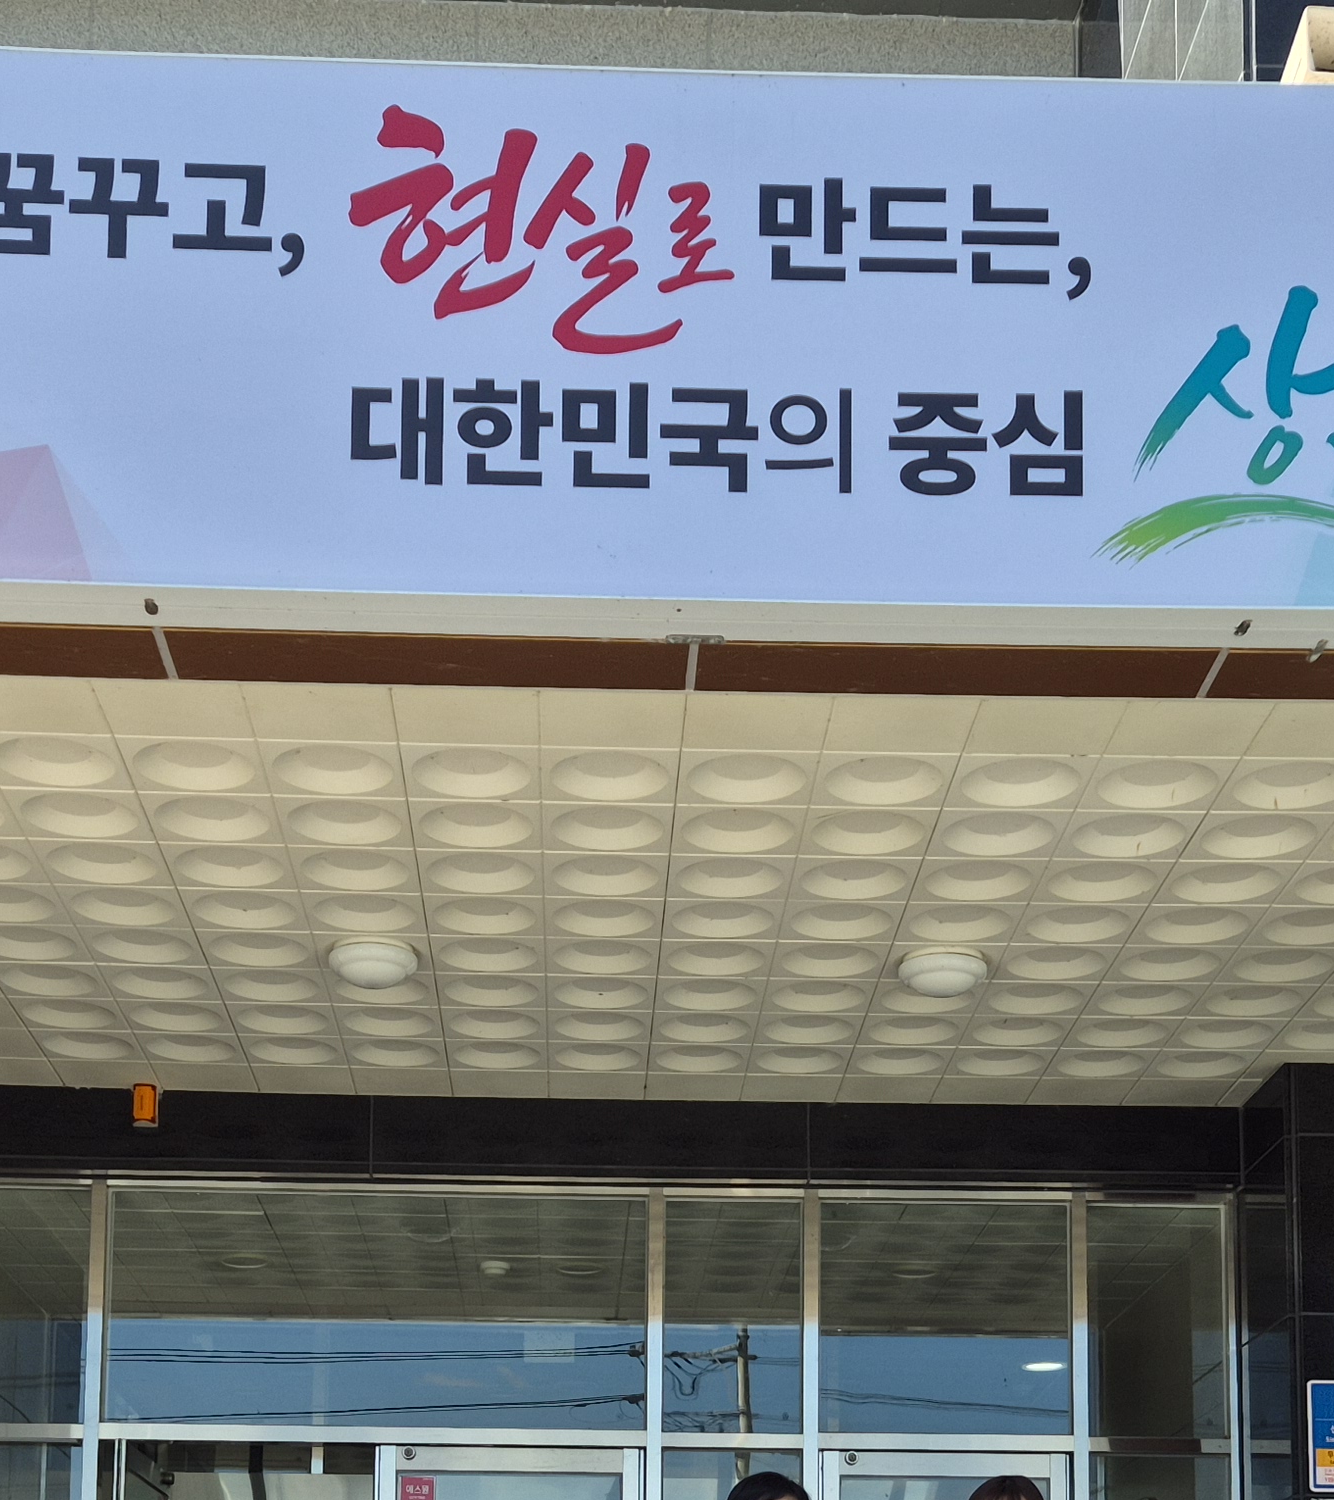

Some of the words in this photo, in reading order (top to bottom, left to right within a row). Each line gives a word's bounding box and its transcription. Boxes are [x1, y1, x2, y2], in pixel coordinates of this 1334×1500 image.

[348, 103, 735, 355] 현실로
[758, 176, 1092, 301] 만드는,
[350, 376, 853, 495] 대한민국의
[888, 390, 1084, 498] 중심
[406, 1485, 430, 1495] 에스원
